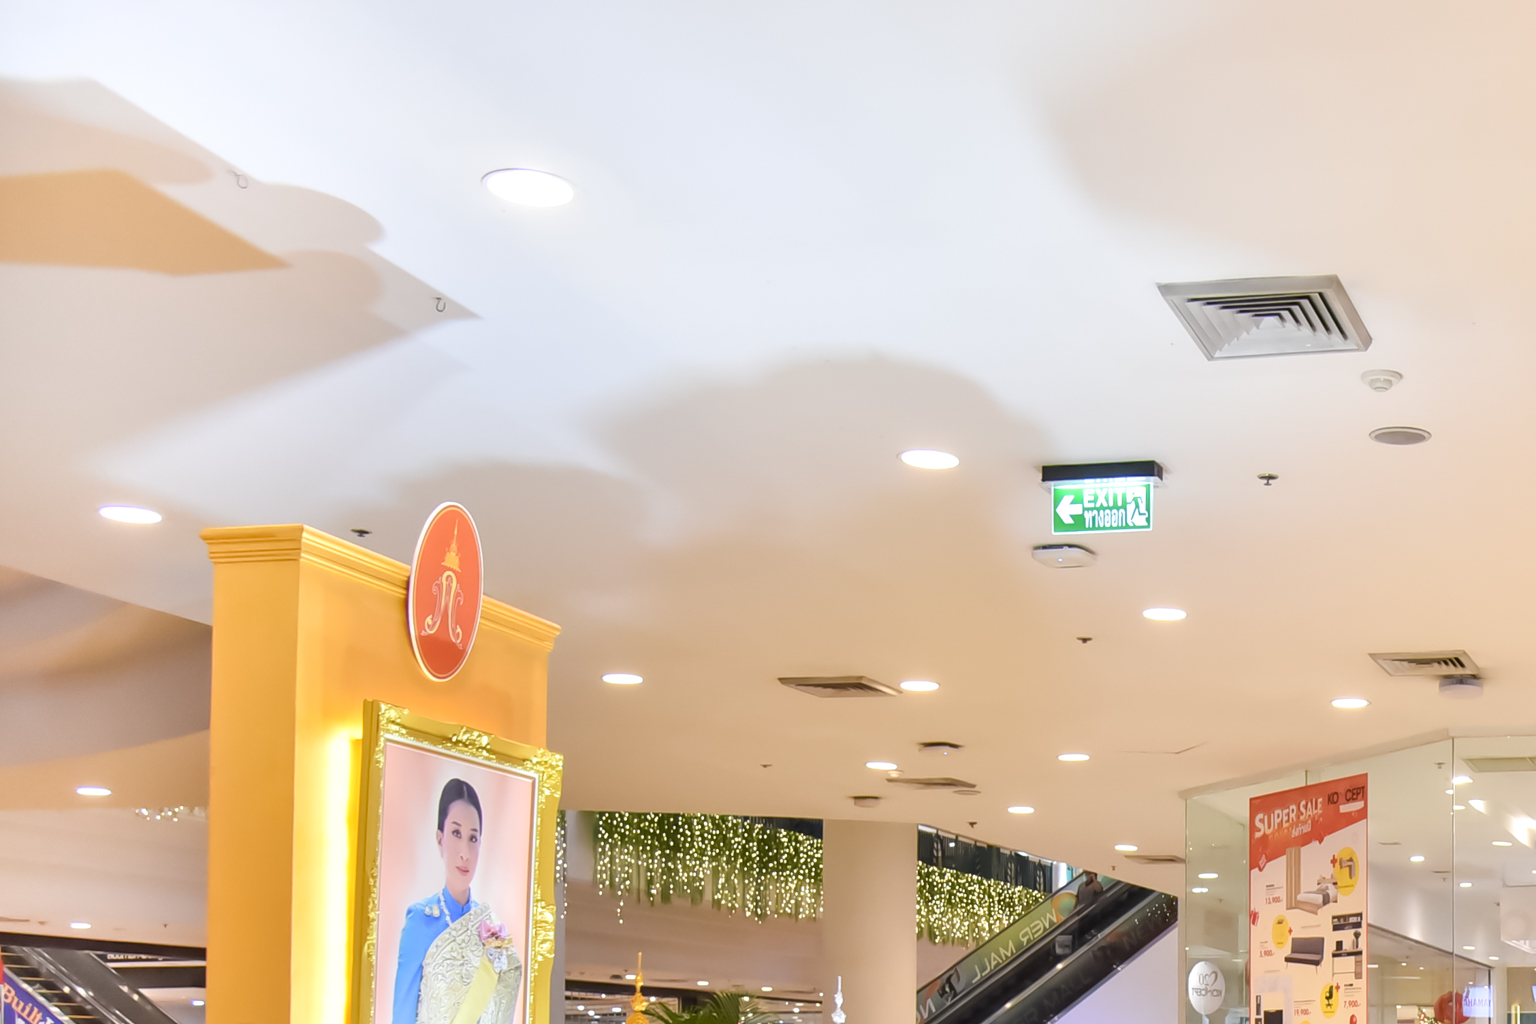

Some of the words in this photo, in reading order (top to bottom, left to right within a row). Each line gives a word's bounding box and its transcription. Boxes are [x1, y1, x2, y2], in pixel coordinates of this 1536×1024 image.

[1083, 488, 1126, 508] EXIT
[1084, 508, 1125, 528] ทางออก
[1327, 786, 1365, 806] KOCEPT
[1254, 803, 1297, 840] SUPER
[1300, 797, 1323, 821] SALE
